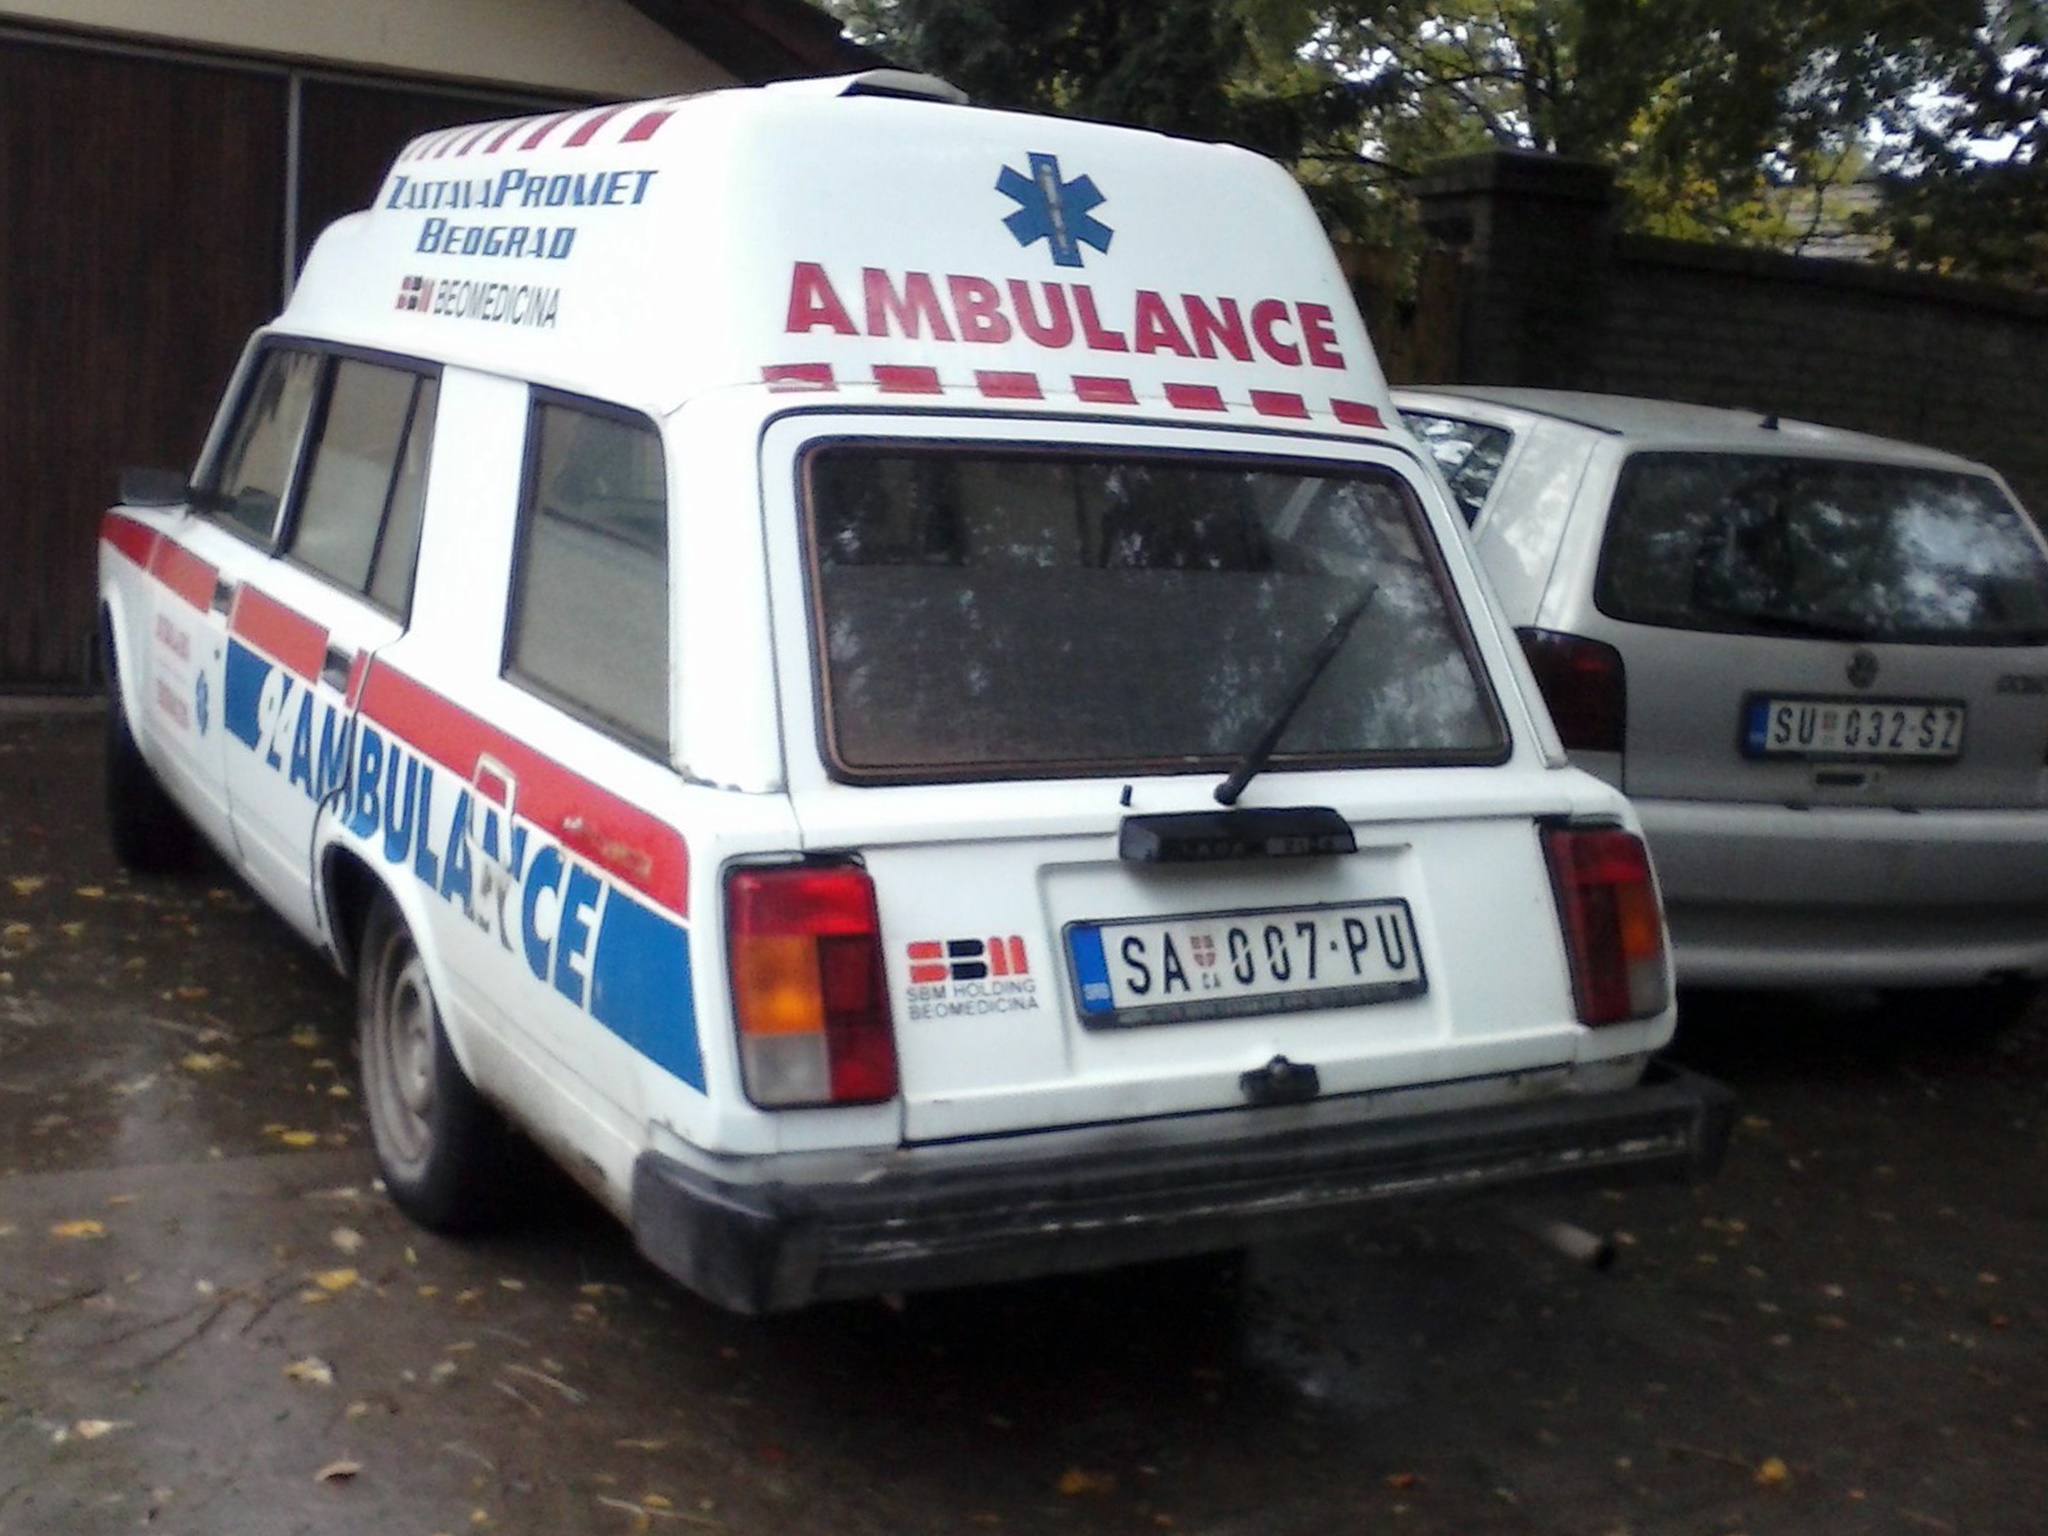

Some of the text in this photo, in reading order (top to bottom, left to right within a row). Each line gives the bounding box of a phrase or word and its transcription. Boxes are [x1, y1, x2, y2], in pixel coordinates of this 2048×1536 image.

[415, 217, 577, 260] BEOGRAD
[433, 278, 560, 329] BEOMEDICINA
[785, 260, 1347, 371] AMBULANCE
[1774, 706, 1816, 745] SU
[1121, 931, 1191, 996] SA
[906, 978, 1037, 1003] SBM HOLDING
[907, 996, 1040, 1020] BEOMEDICINA
